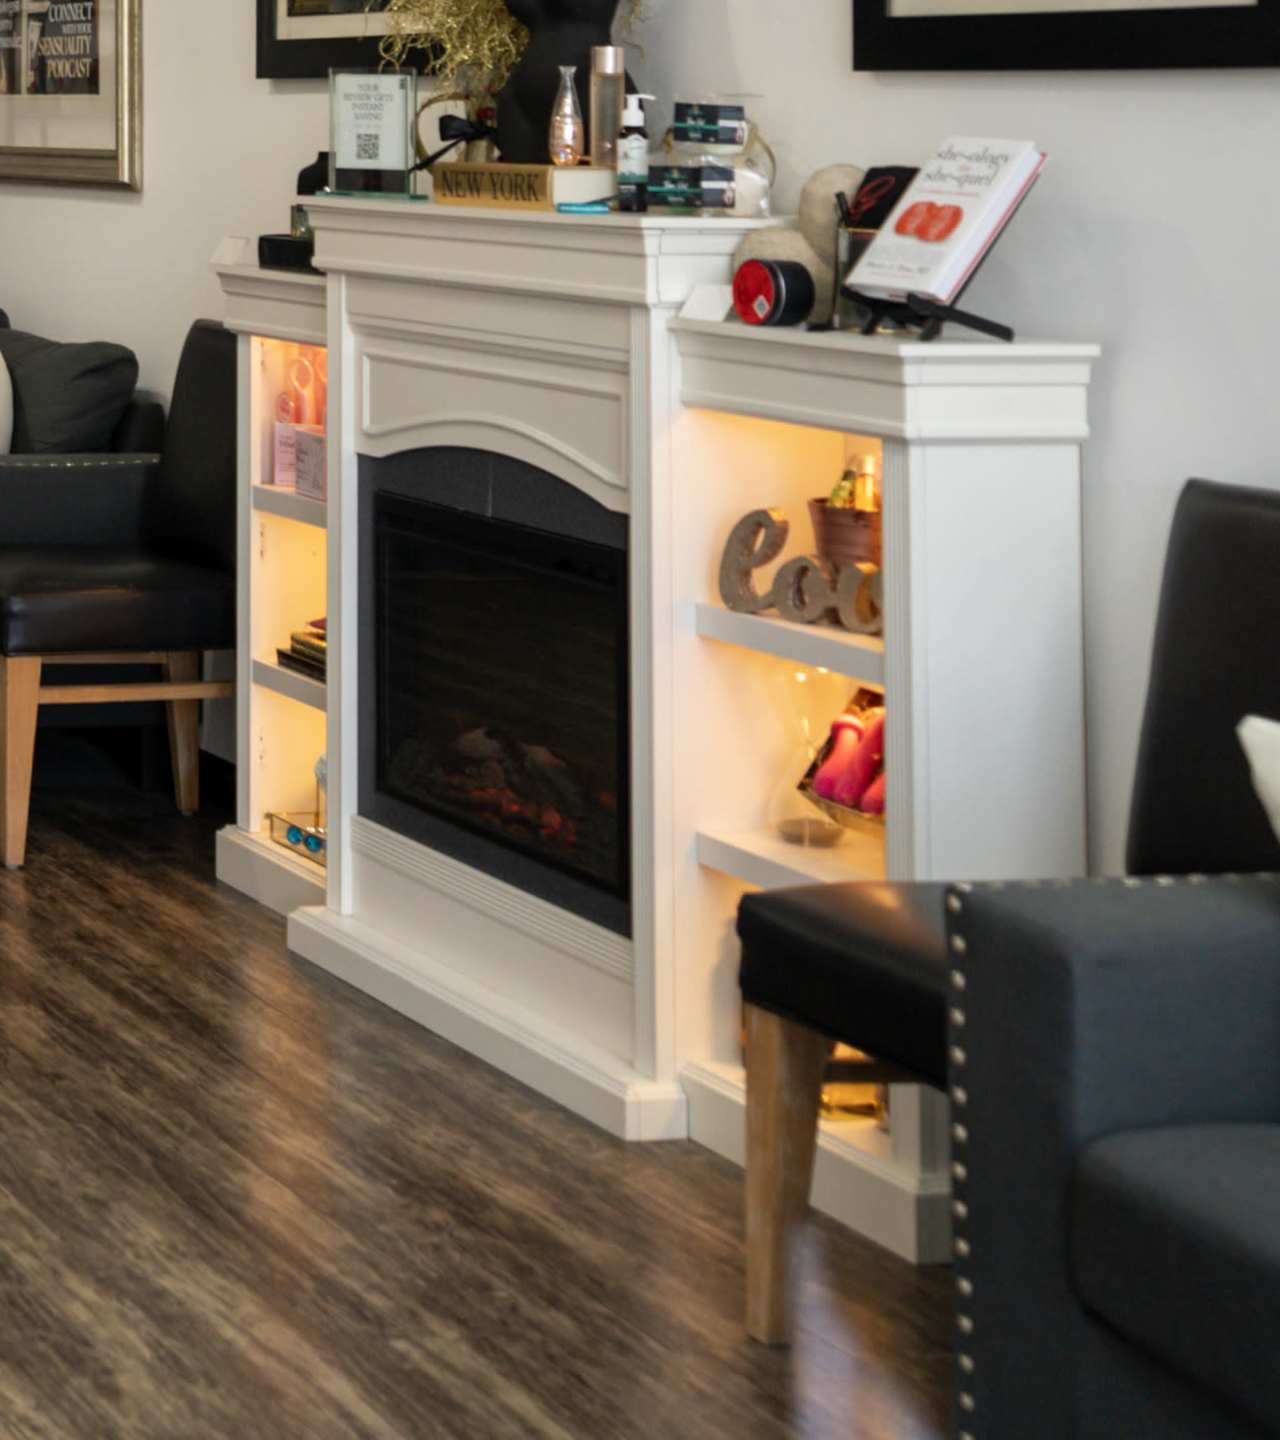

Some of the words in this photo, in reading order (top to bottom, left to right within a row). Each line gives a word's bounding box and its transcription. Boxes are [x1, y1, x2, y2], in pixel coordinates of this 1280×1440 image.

[48, 2, 94, 23] CONNECT
[38, 35, 92, 56] SENSUALITY
[47, 58, 93, 78] PODCAST
[442, 169, 485, 198] NEW
[488, 172, 541, 202] YORK
